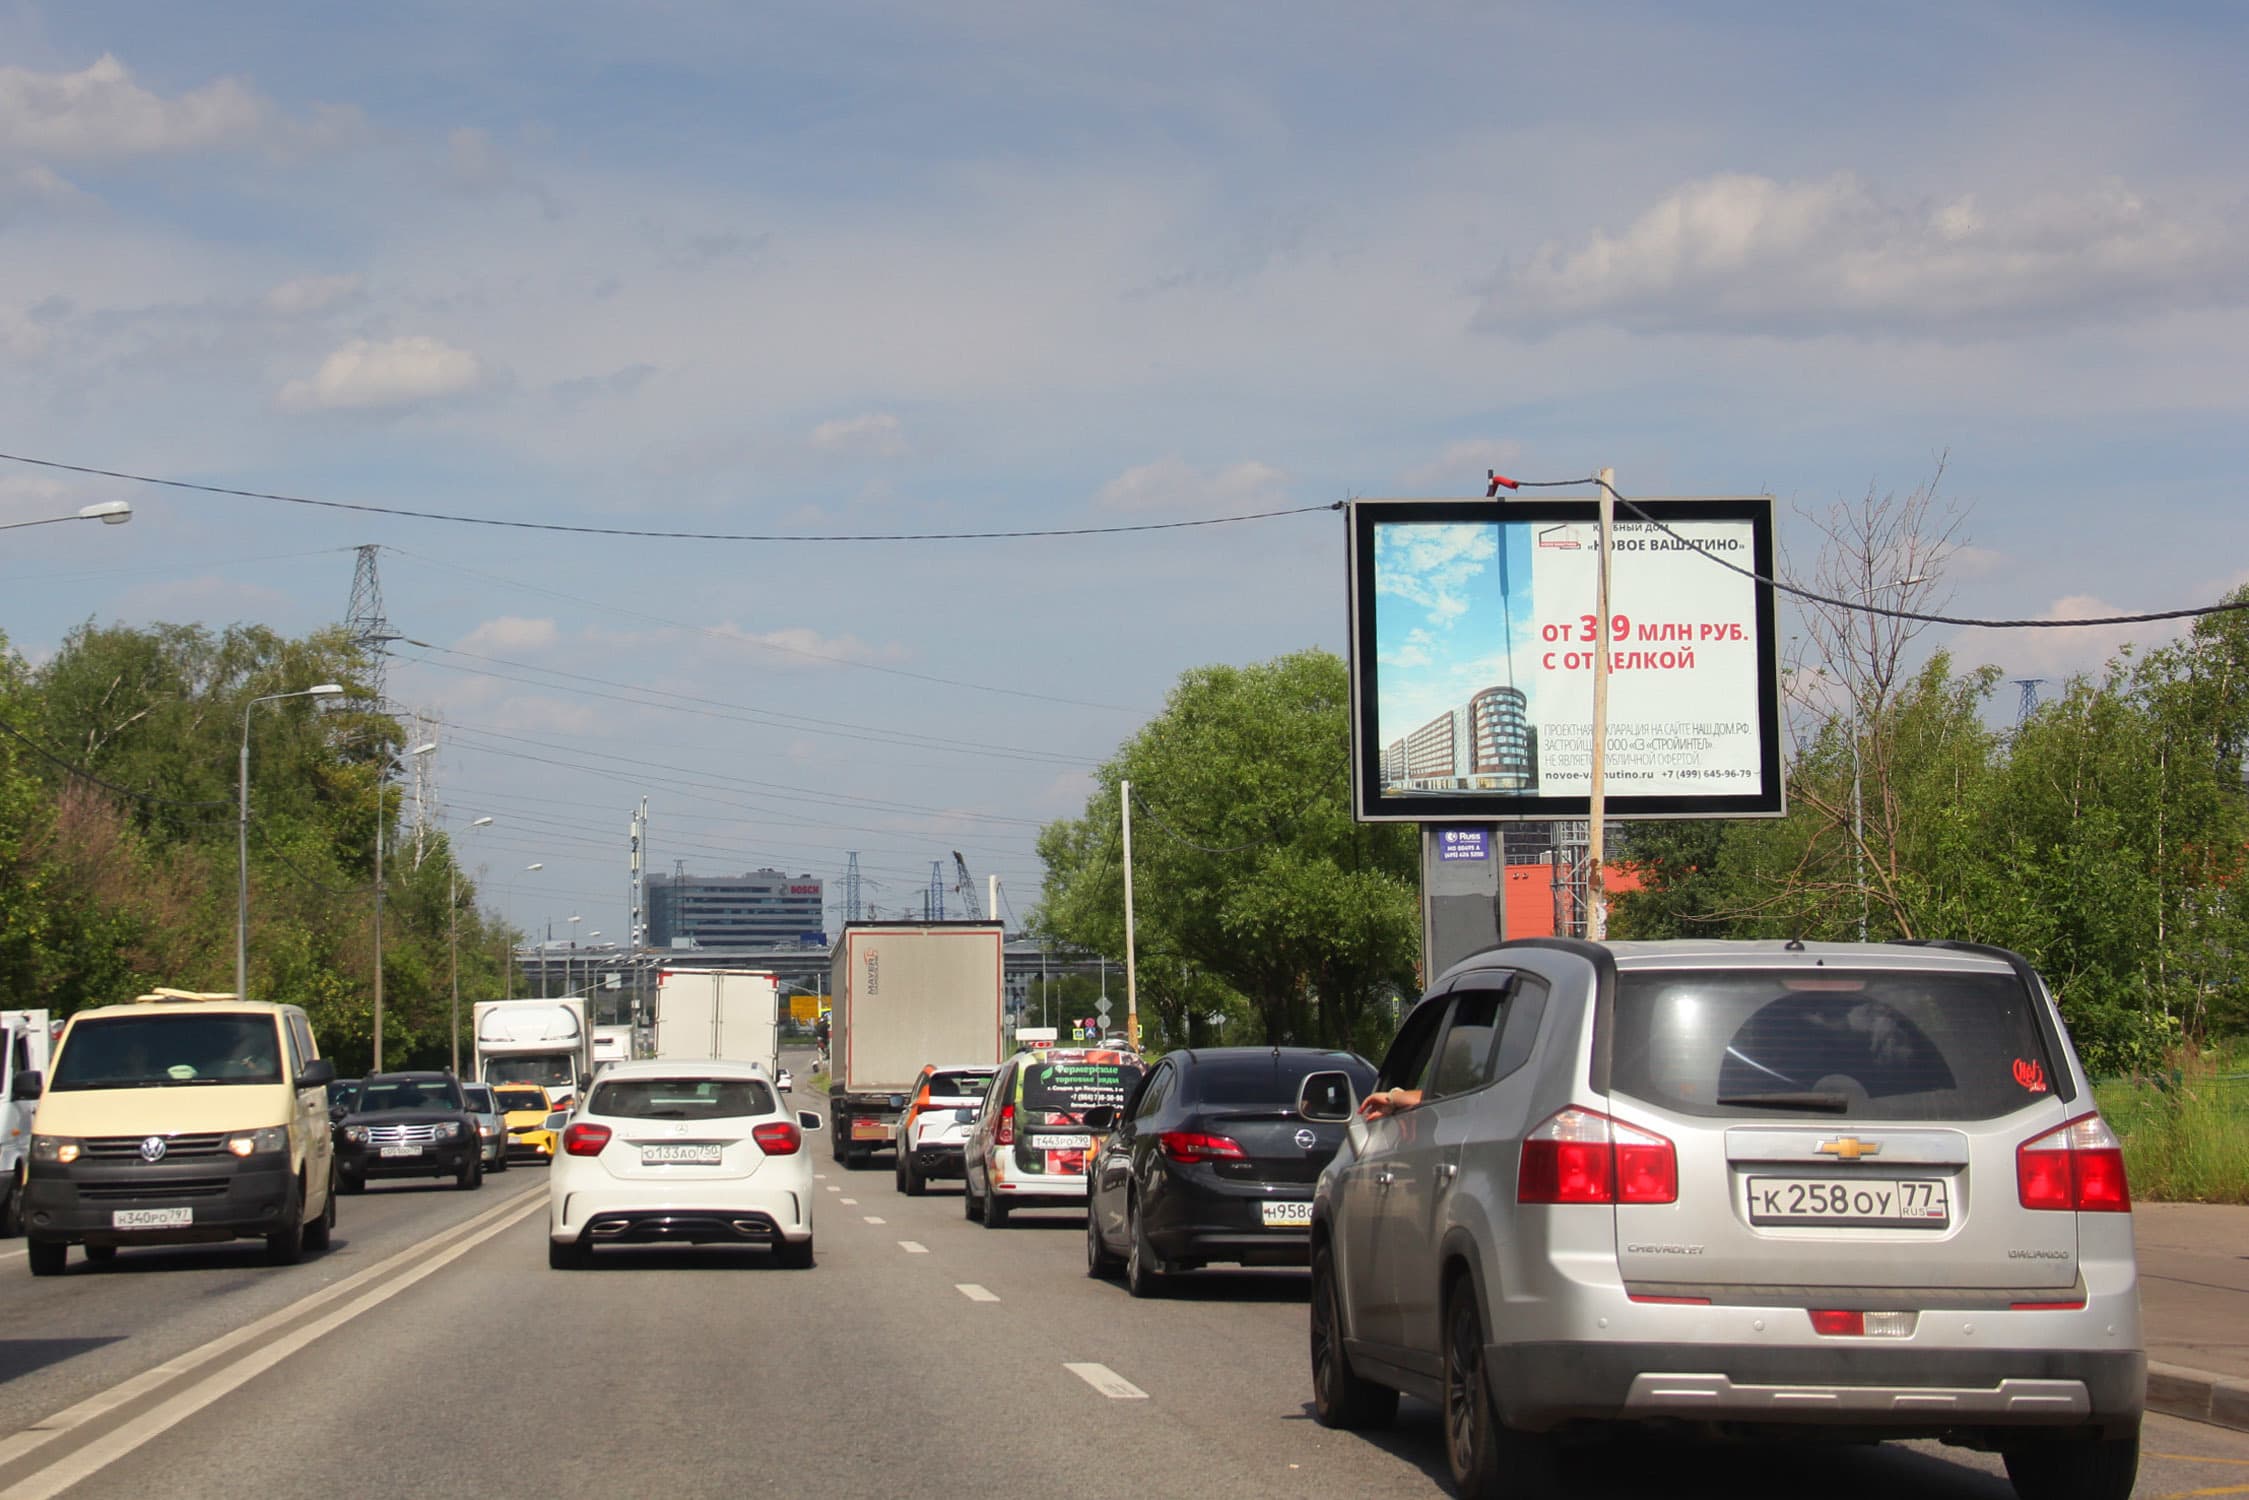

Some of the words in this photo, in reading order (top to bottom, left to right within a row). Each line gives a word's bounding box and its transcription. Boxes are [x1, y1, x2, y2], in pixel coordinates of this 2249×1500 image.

[1542, 624, 1572, 642] ОТ
[1579, 614, 1631, 642] 39
[1638, 623, 1693, 641] МЛН
[1699, 623, 1749, 641] РУБ.
[1542, 652, 1556, 670] С
[1563, 646, 1695, 674] ОТЕЛКОЙ
[1662, 770, 1673, 779] +7
[1676, 769, 1701, 780] (499)
[1703, 769, 1752, 779] 645-96-79
[1903, 1207, 1926, 1217] RUS
